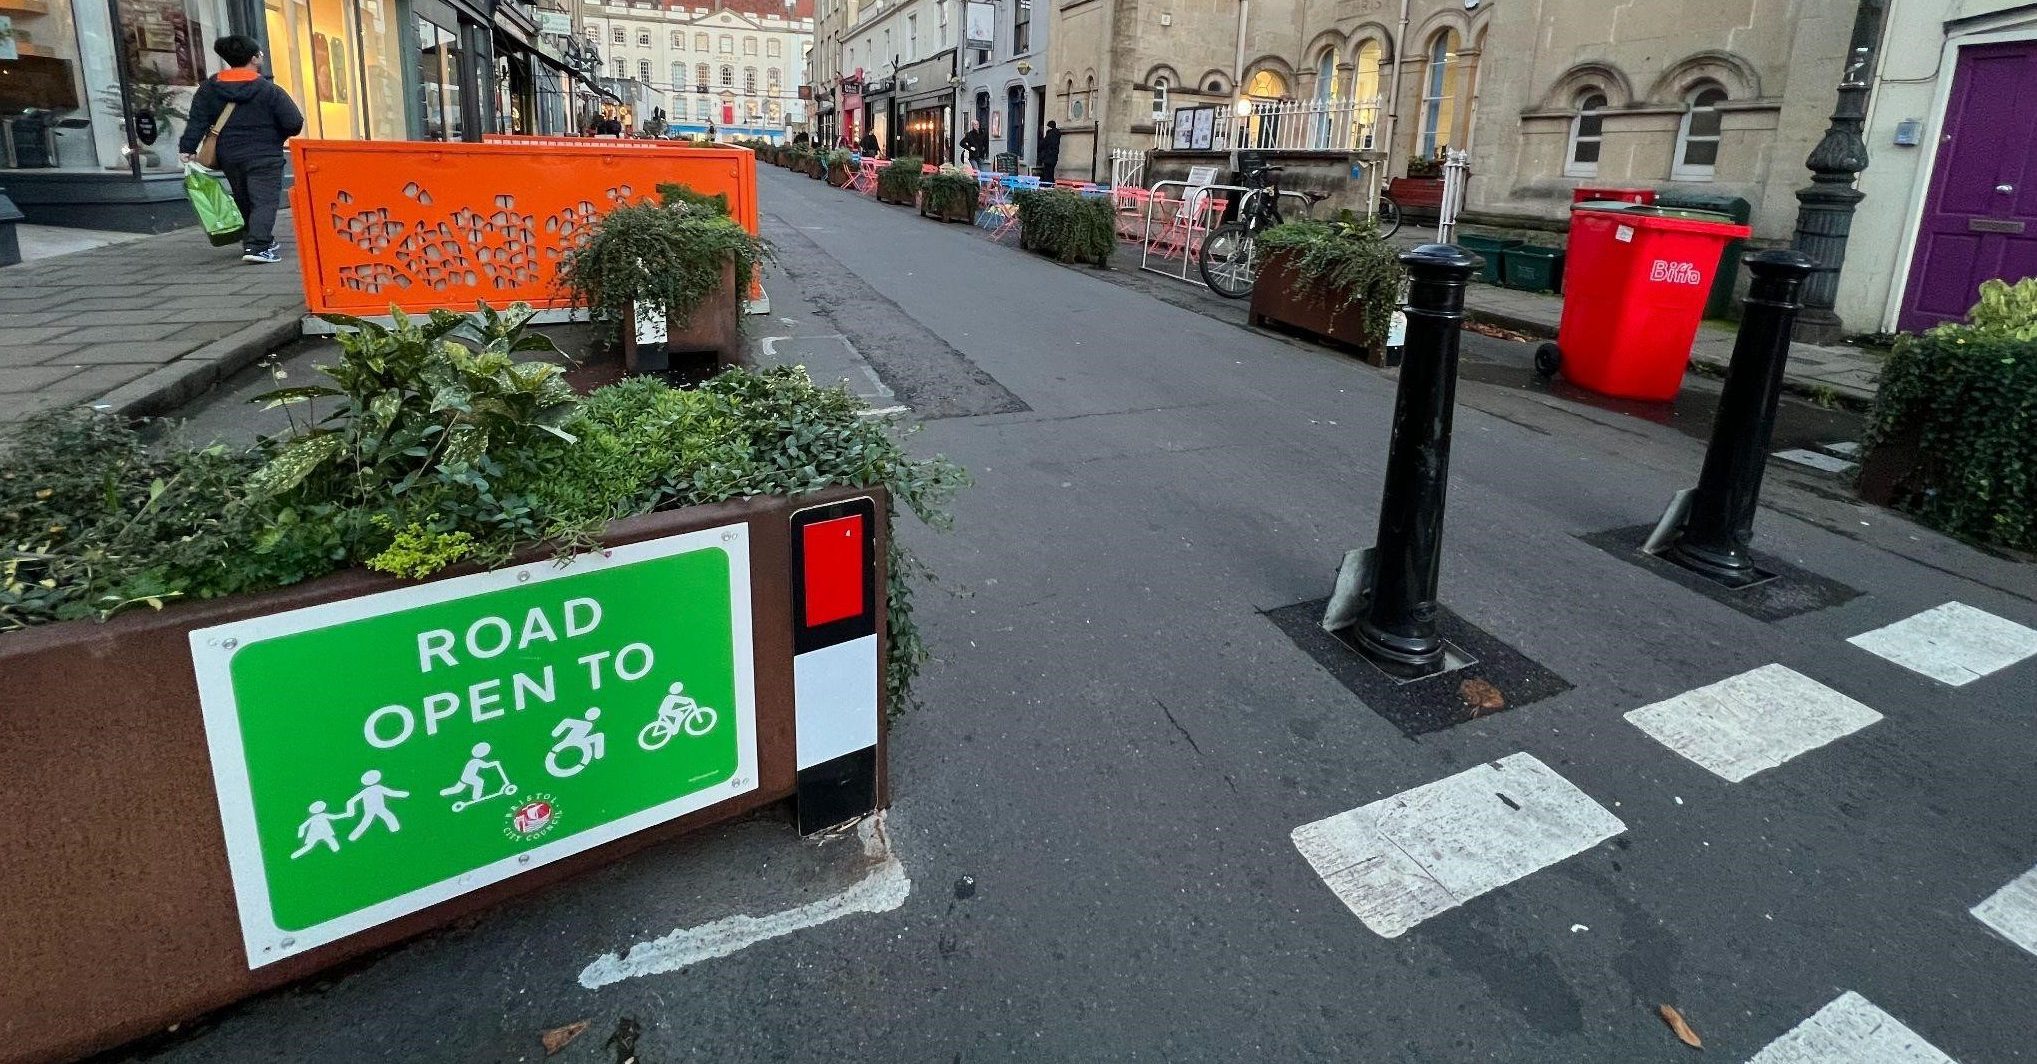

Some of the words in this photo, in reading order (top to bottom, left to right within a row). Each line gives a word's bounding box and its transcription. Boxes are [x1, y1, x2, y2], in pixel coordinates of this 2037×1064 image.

[1650, 260, 1700, 285] Biffa
[417, 597, 602, 673] ROAD
[363, 665, 556, 749] OPEN
[577, 642, 654, 690] TO
[505, 792, 557, 818] BRISTOL
[503, 827, 521, 842] CITY
[526, 810, 562, 841] COUNCIL
